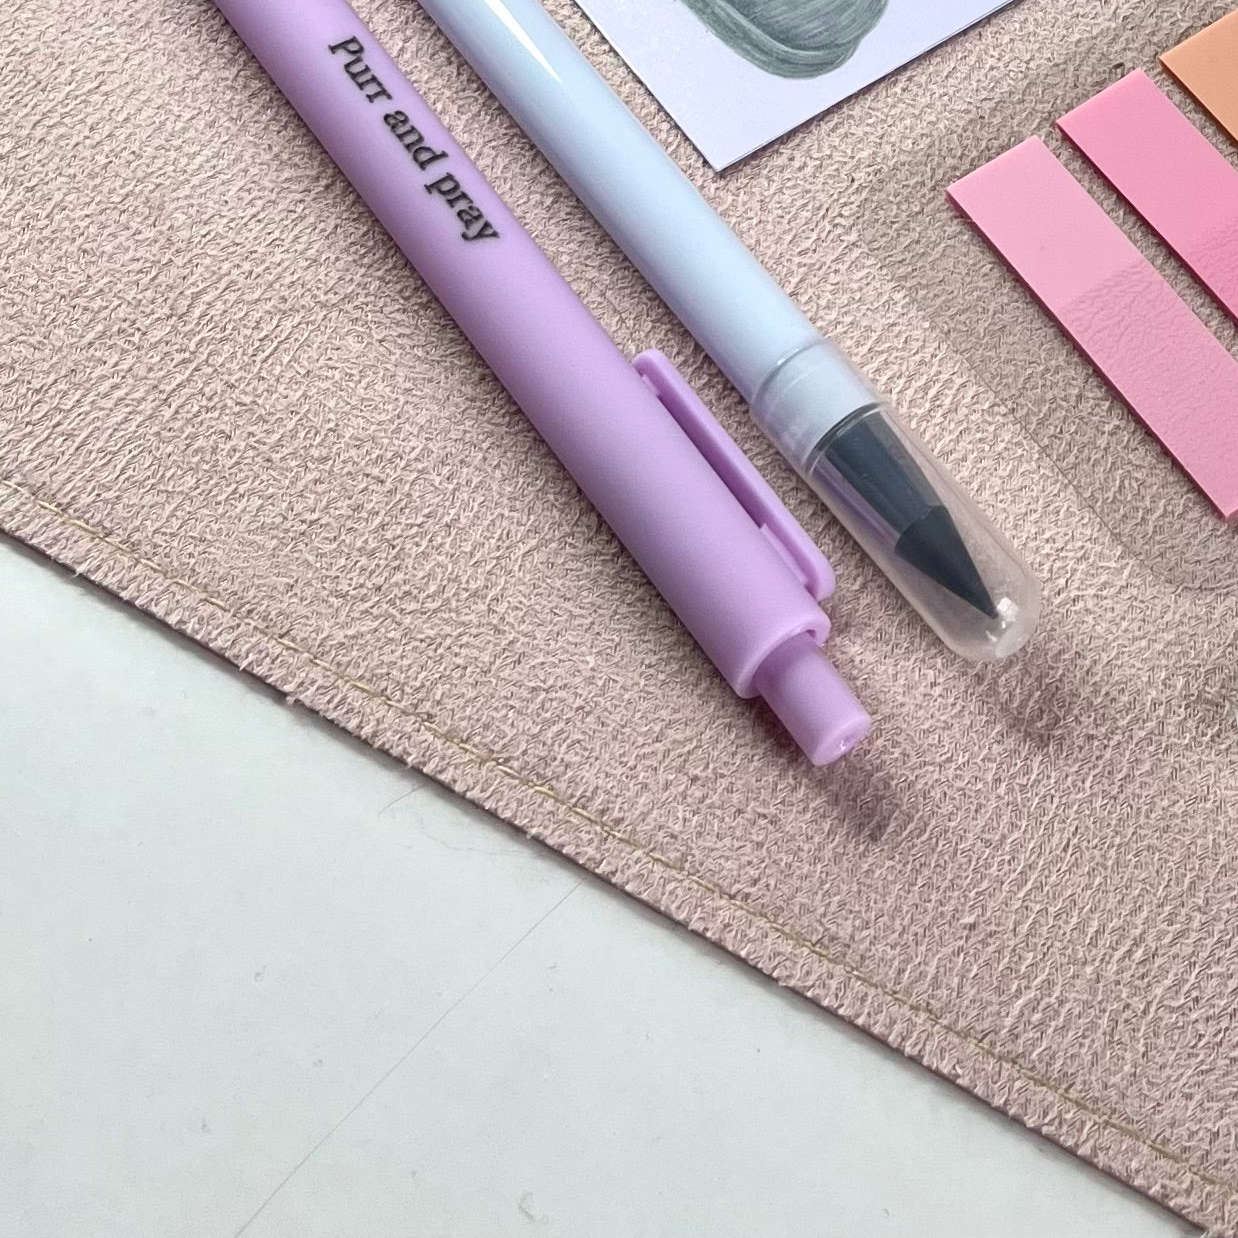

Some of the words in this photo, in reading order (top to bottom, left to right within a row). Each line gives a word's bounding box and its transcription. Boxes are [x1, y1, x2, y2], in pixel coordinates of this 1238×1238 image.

[327, 35, 393, 104] Purr
[383, 110, 449, 171] and
[424, 172, 501, 242] pray
